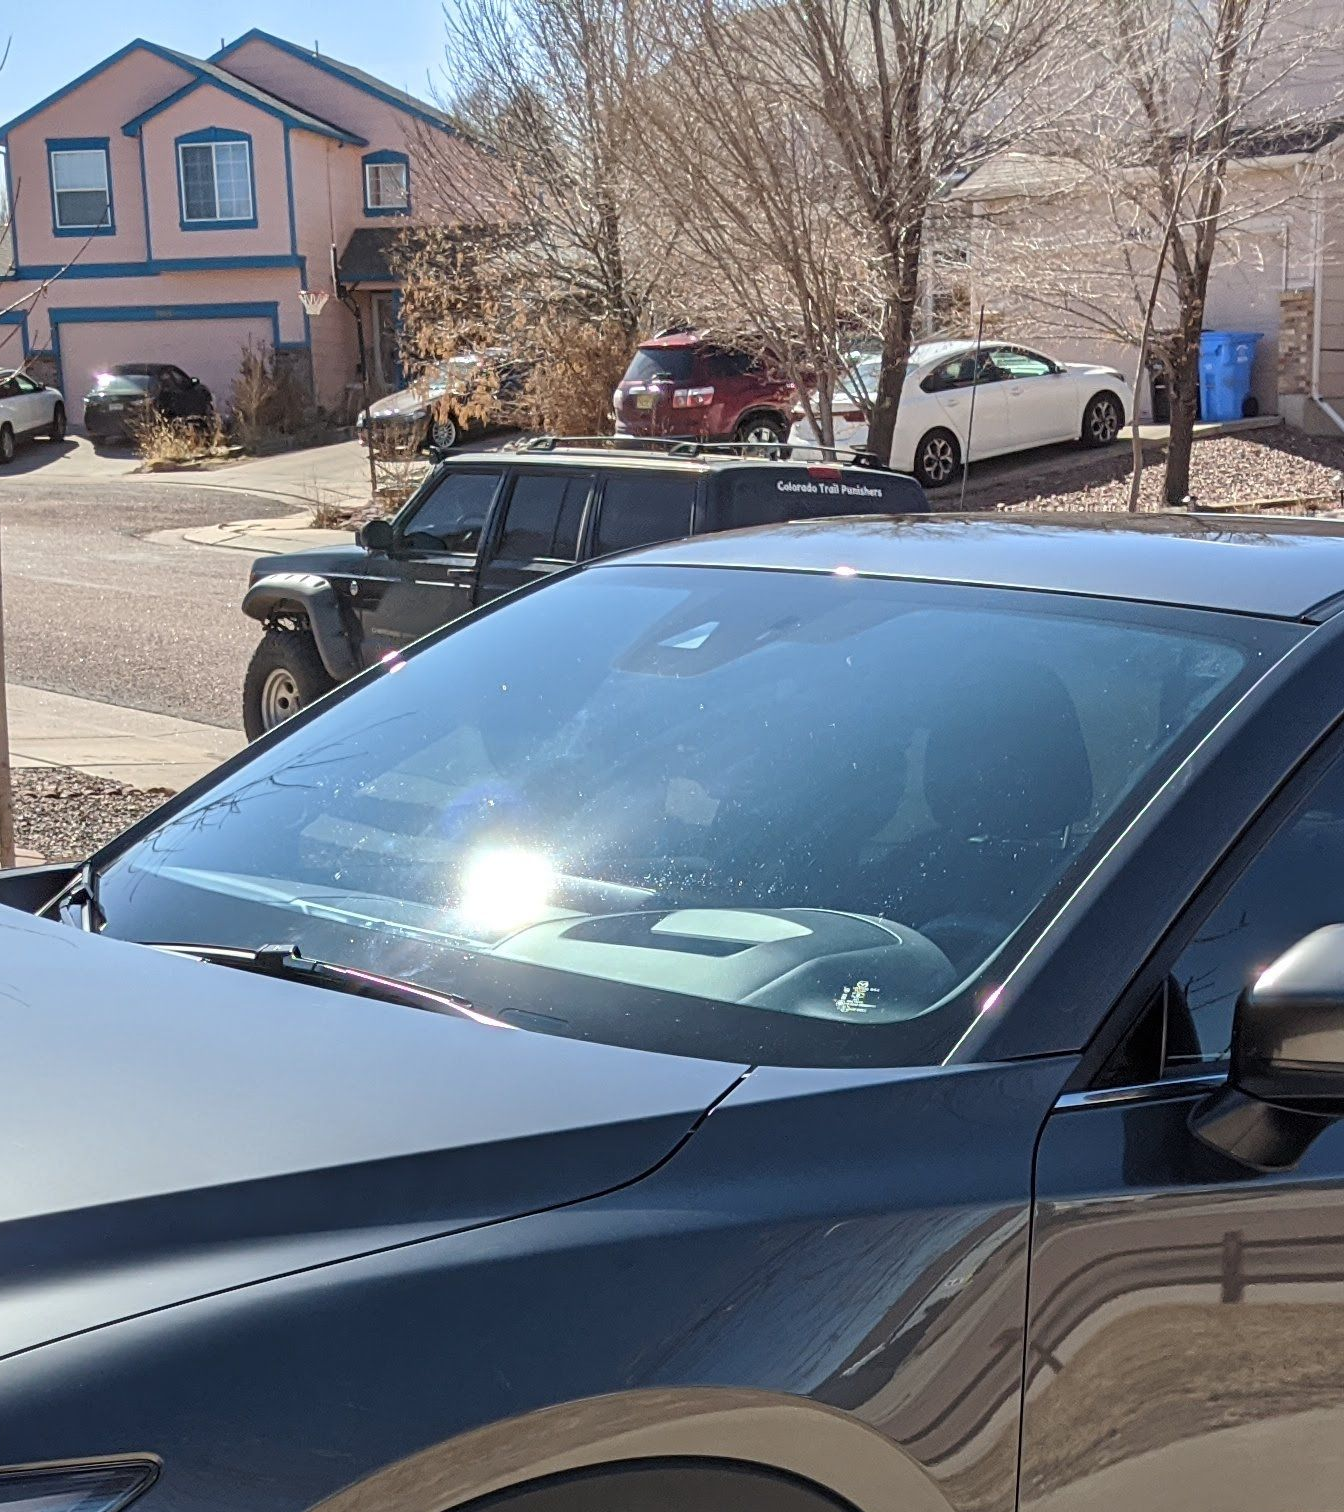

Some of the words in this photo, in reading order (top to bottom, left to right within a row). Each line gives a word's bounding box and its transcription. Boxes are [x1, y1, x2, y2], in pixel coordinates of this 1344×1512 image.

[776, 480, 817, 493] Colorado
[818, 483, 839, 494] Trail
[841, 485, 883, 498] Punishers
